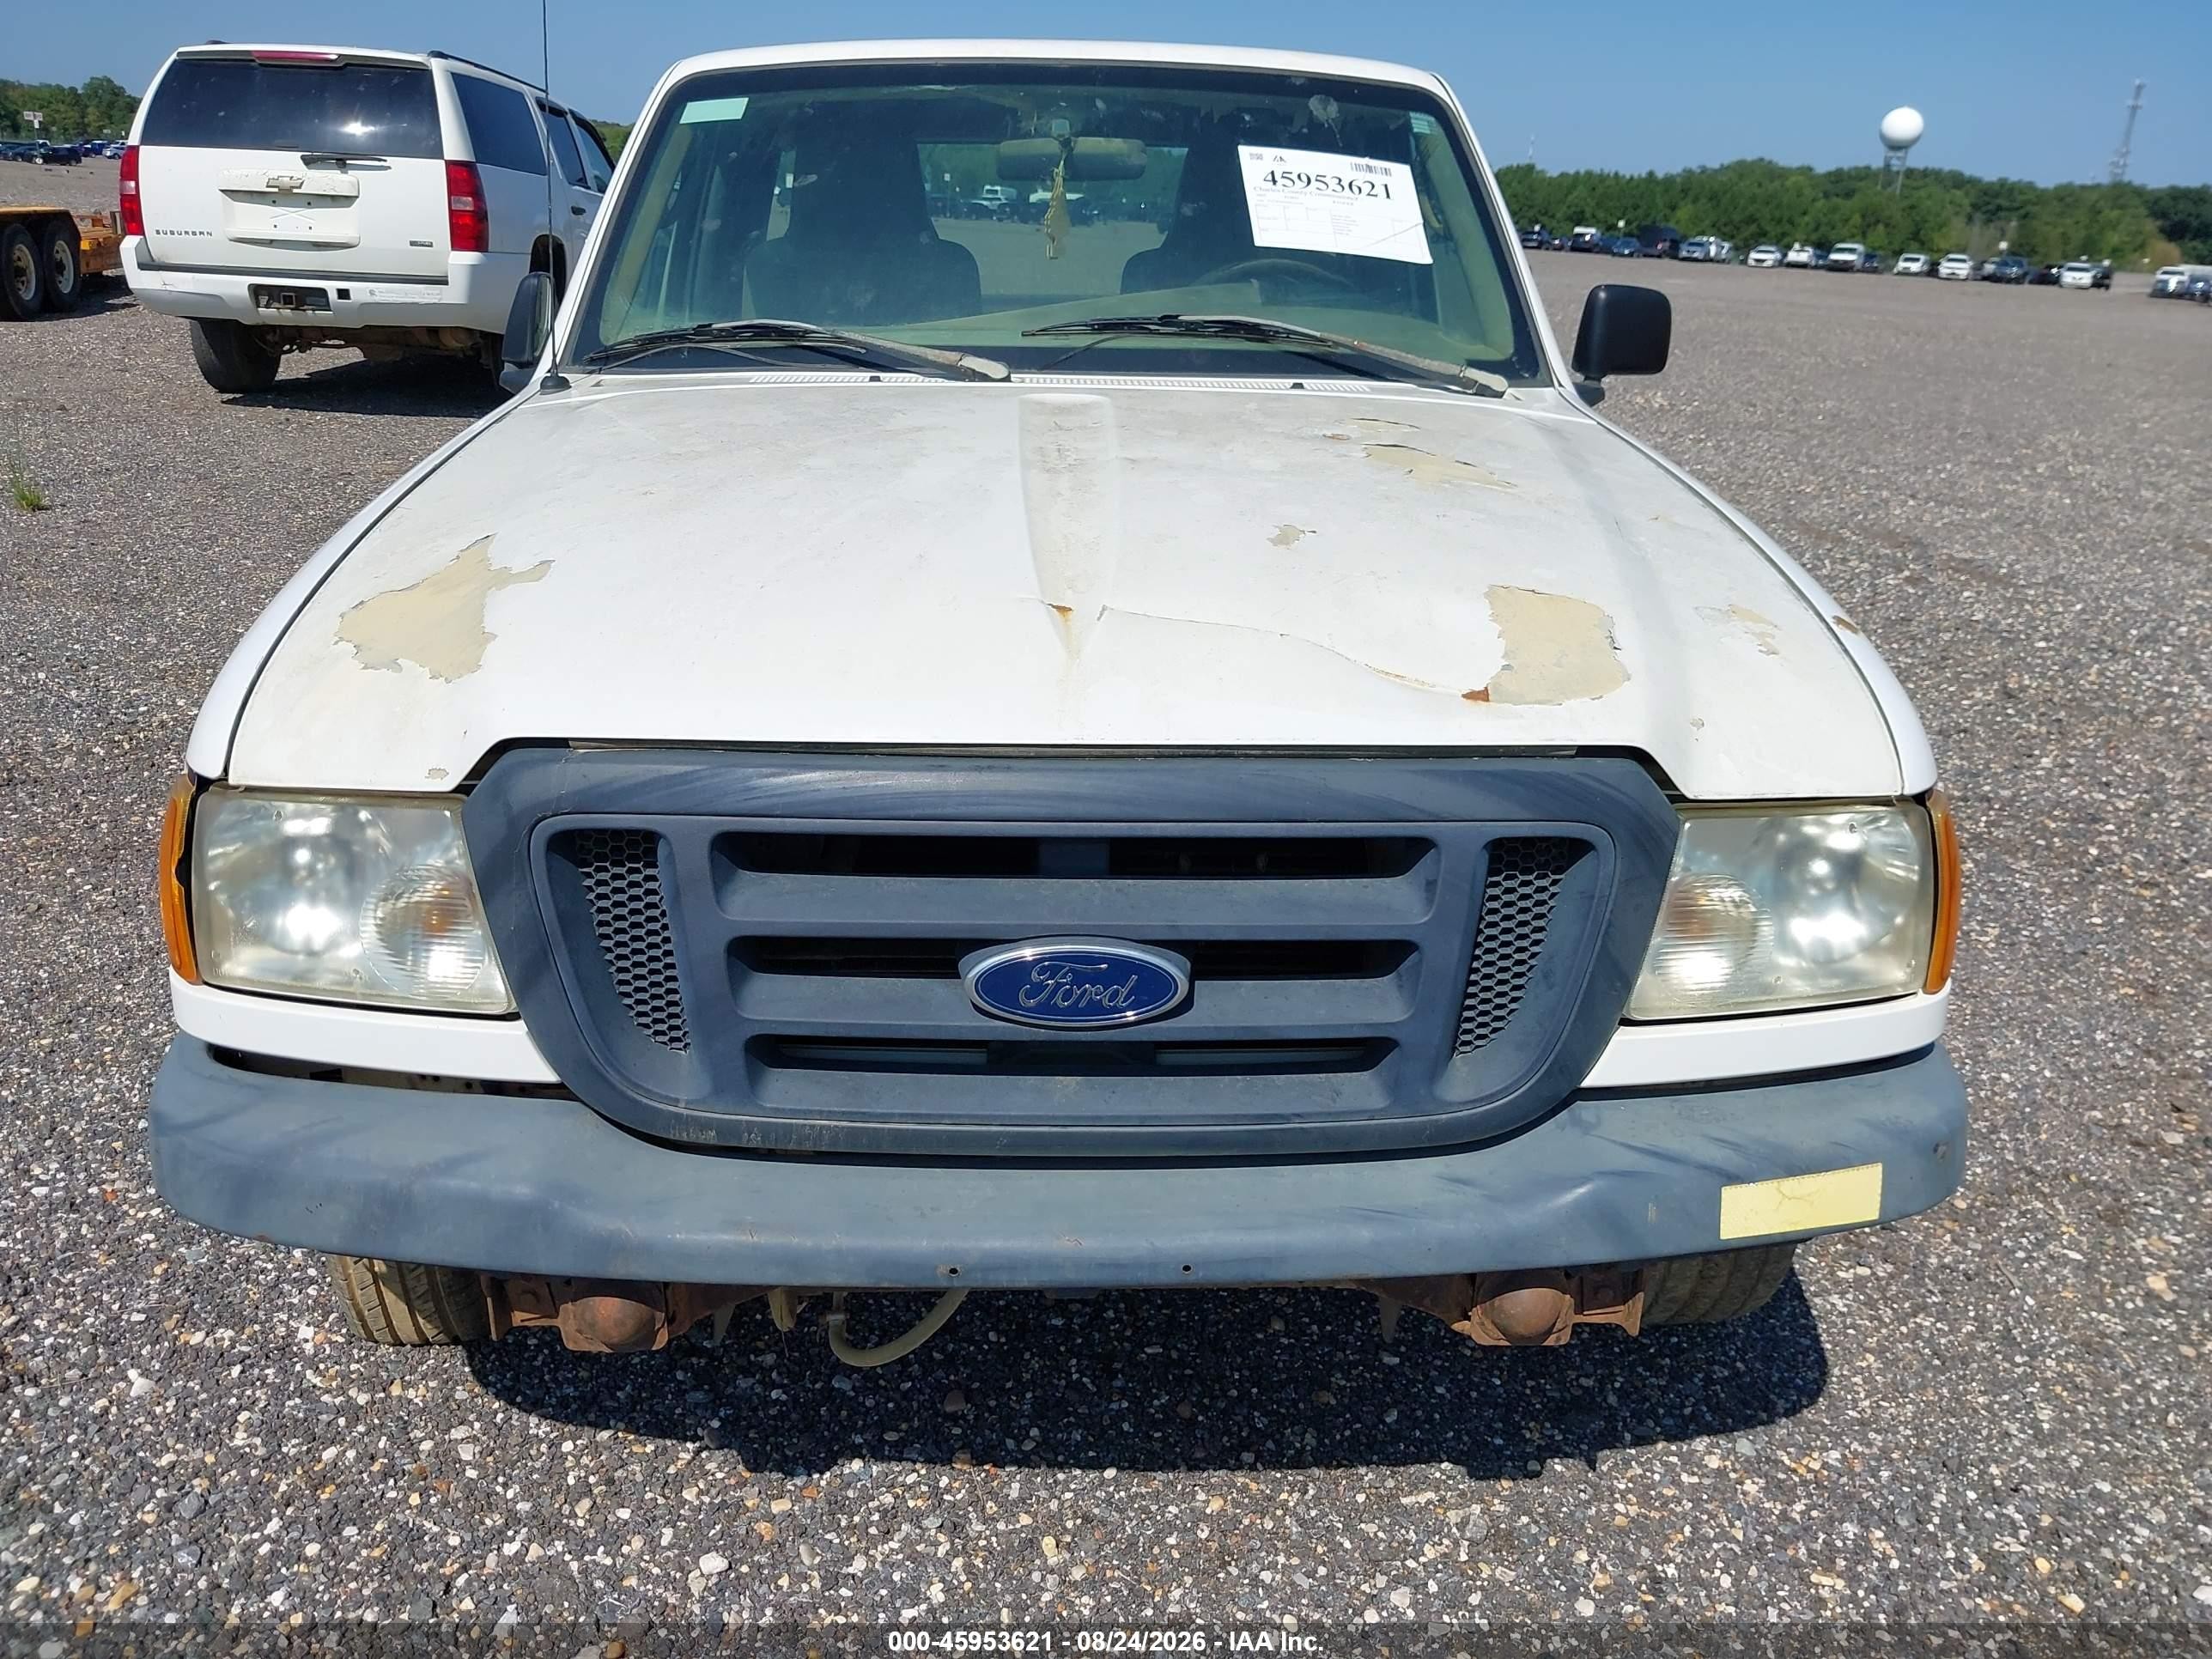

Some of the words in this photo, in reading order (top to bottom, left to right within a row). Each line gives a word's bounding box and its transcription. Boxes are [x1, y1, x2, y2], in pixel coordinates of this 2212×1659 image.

[1263, 169, 1393, 200] 45953621
[155, 228, 213, 237] SUBURBAN
[1018, 961, 1138, 1009] Ford
